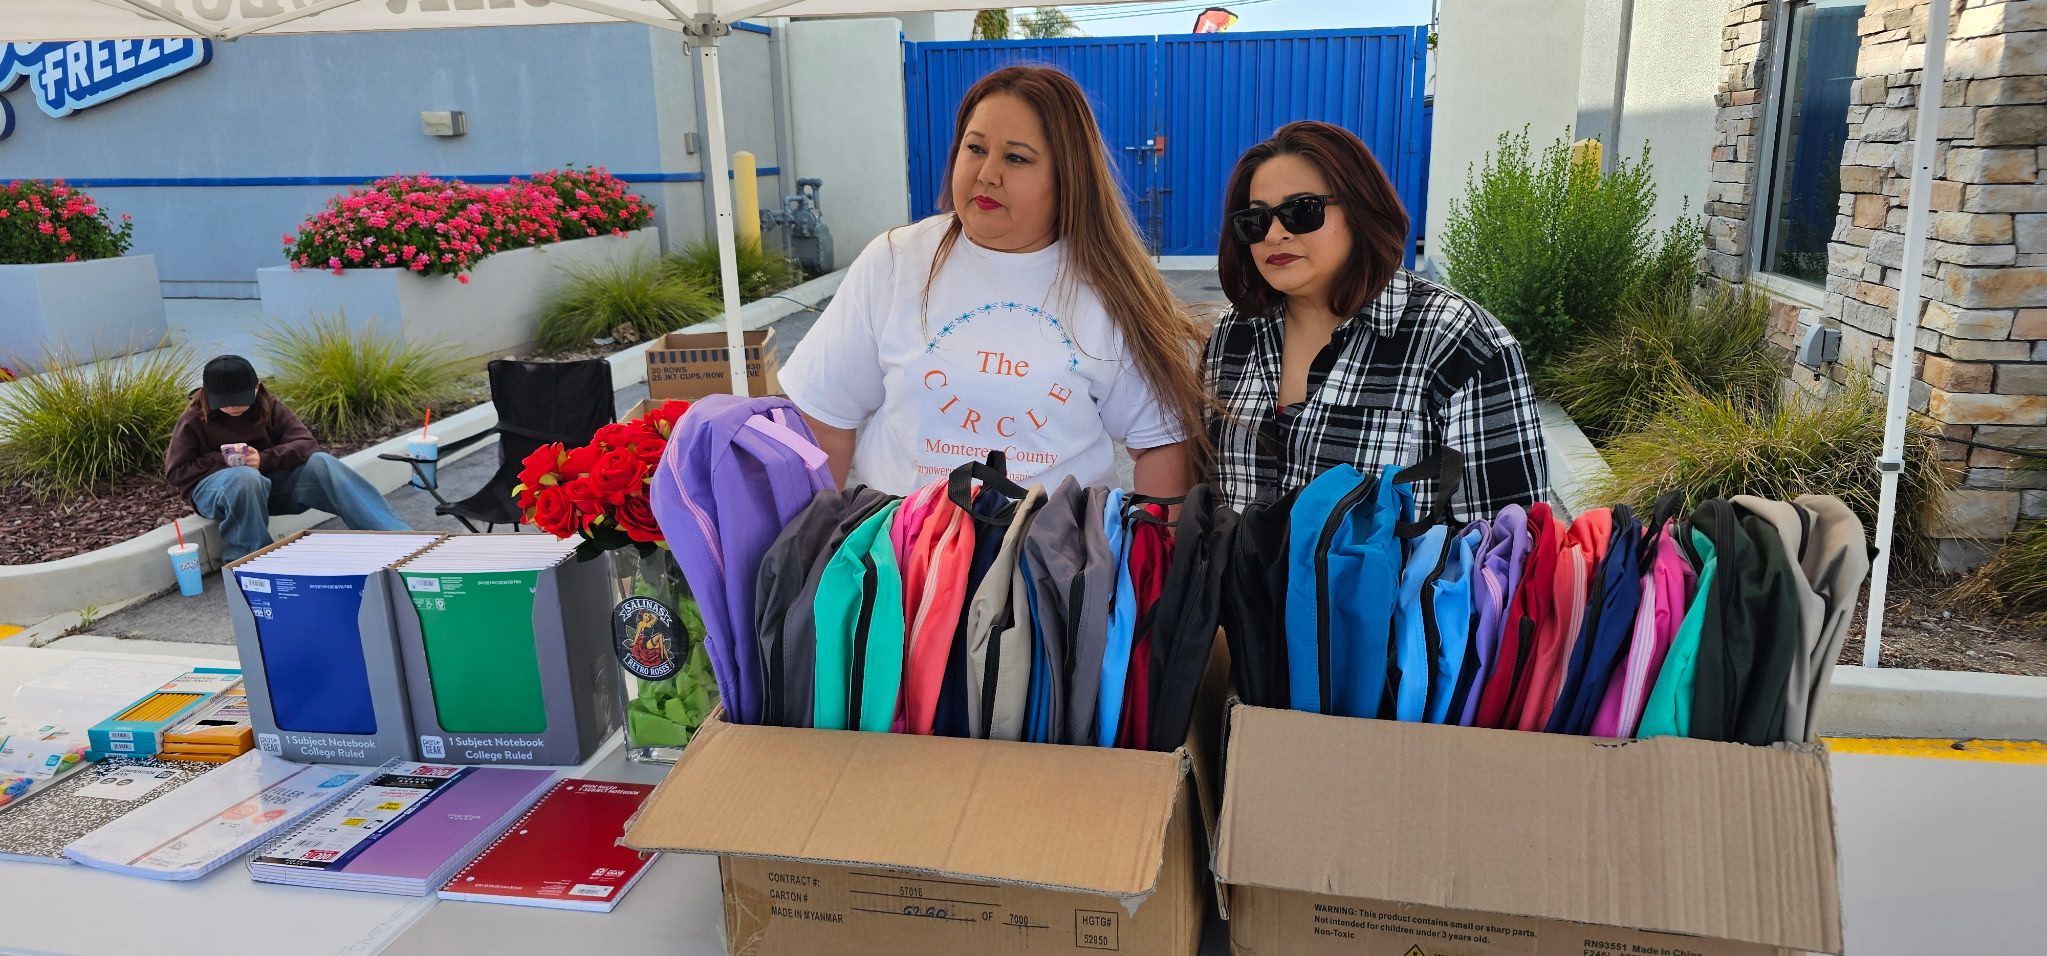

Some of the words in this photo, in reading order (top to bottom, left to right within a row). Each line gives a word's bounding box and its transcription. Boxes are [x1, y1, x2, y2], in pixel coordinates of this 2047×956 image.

[977, 350, 1029, 377] The
[664, 373, 677, 381] JKT
[680, 372, 724, 380] CUPS/ROW
[746, 370, 760, 378] EVE
[924, 370, 1072, 437] CIRCLE
[925, 438, 998, 458] Montere
[1003, 446, 1058, 468] County
[624, 600, 666, 616] SALINAS
[627, 659, 649, 675] RETRO
[650, 663, 670, 676] ROSES
[286, 736, 290, 744] 1
[292, 736, 327, 747] Subject
[328, 738, 376, 749] Notebook
[449, 737, 454, 746] 1
[455, 737, 493, 748] Subject
[495, 738, 544, 747] Notebook
[300, 747, 336, 758] College
[338, 748, 365, 758] Ruled
[425, 746, 442, 754] GEAR
[465, 750, 502, 761] College
[504, 751, 533, 760] Ruled
[268, 787, 305, 798] FILLER
[258, 794, 291, 805] PAPER
[768, 872, 811, 886] CONTRACT
[769, 889, 802, 902] CARTON
[803, 893, 808, 902] #
[771, 905, 793, 918] MADE
[794, 908, 802, 919] IN
[803, 910, 844, 923] MYANMAR
[982, 911, 993, 921] OF
[1009, 914, 1029, 925] 7000
[1082, 915, 1112, 928] HGTG#
[1314, 903, 1357, 916] WARNING:
[1359, 909, 1377, 919] This
[1378, 911, 1411, 923] product
[1412, 915, 1449, 927] contains
[1450, 920, 1474, 931] small
[1475, 923, 1484, 932] or
[1486, 924, 1511, 936] sharp
[1512, 927, 1538, 939] parts.
[1314, 915, 1329, 924] Not
[1330, 916, 1366, 929] intended
[1366, 920, 1379, 930] for
[1380, 922, 1414, 935] children
[1416, 926, 1441, 937] under
[1442, 930, 1447, 938] 3
[1448, 932, 1472, 943] years
[1473, 934, 1490, 944] old.
[1314, 926, 1355, 939] Non-Toxic
[1084, 935, 1108, 946] 52950
[1584, 939, 1627, 951] RN93551
[1632, 944, 1659, 955] Made
[1661, 948, 1671, 956] in
